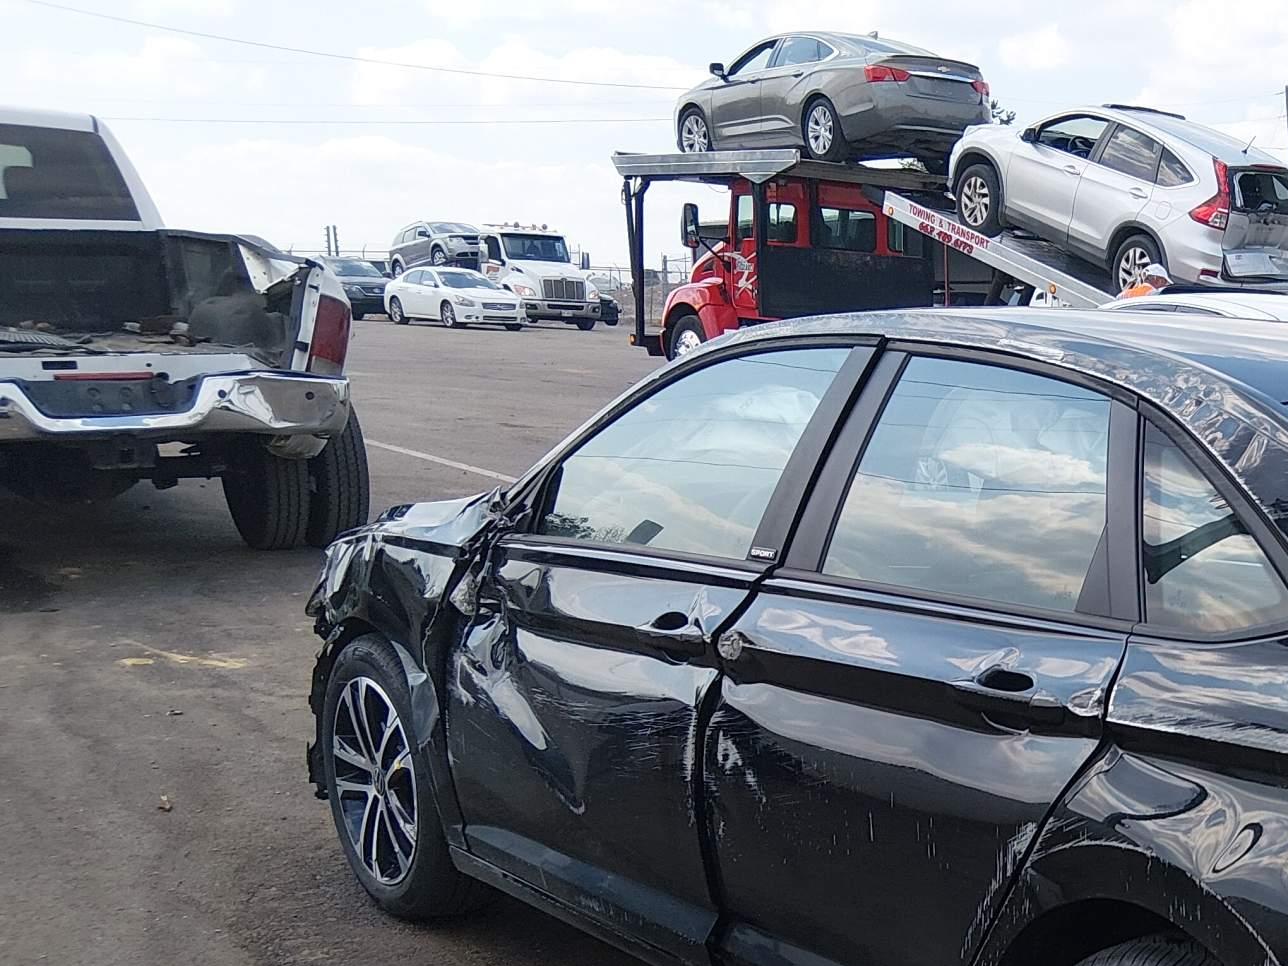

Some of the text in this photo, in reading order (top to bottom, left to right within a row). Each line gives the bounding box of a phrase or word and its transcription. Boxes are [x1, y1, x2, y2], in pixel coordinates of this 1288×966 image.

[909, 204, 936, 223] TOWING
[947, 222, 990, 248] TRANSPORT
[751, 549, 775, 558] SPORT
